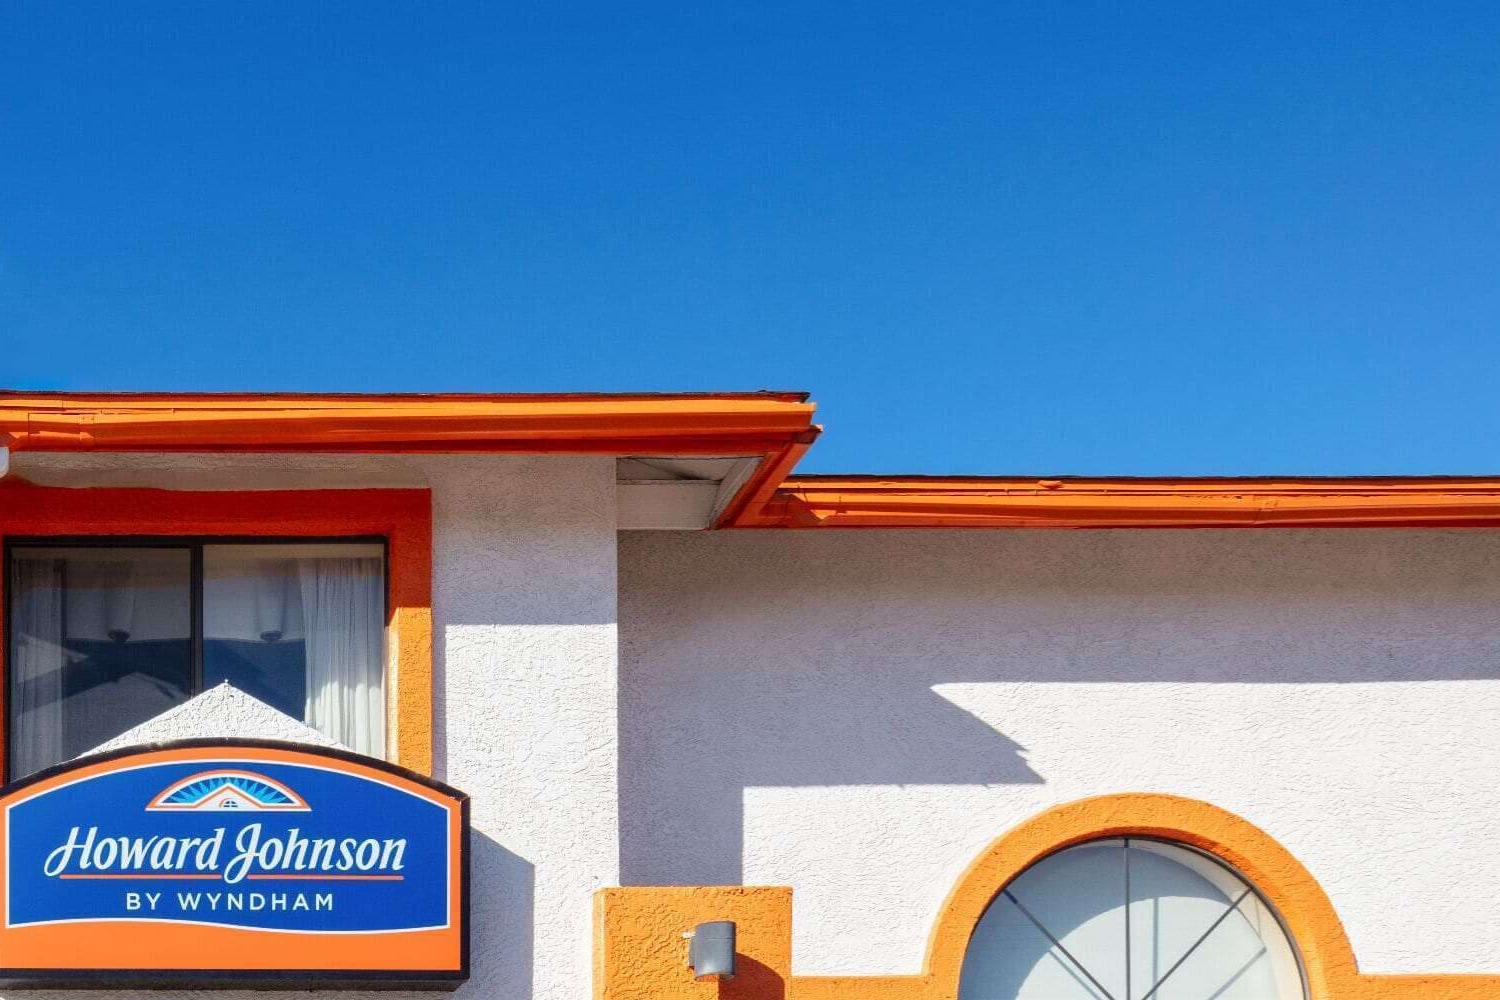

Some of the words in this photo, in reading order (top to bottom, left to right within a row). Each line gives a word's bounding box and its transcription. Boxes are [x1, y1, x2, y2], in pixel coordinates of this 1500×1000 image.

[43, 824, 226, 877] Howard
[223, 823, 407, 884] Johnson
[125, 893, 160, 911] BY
[178, 893, 334, 912] WYNDHAM
